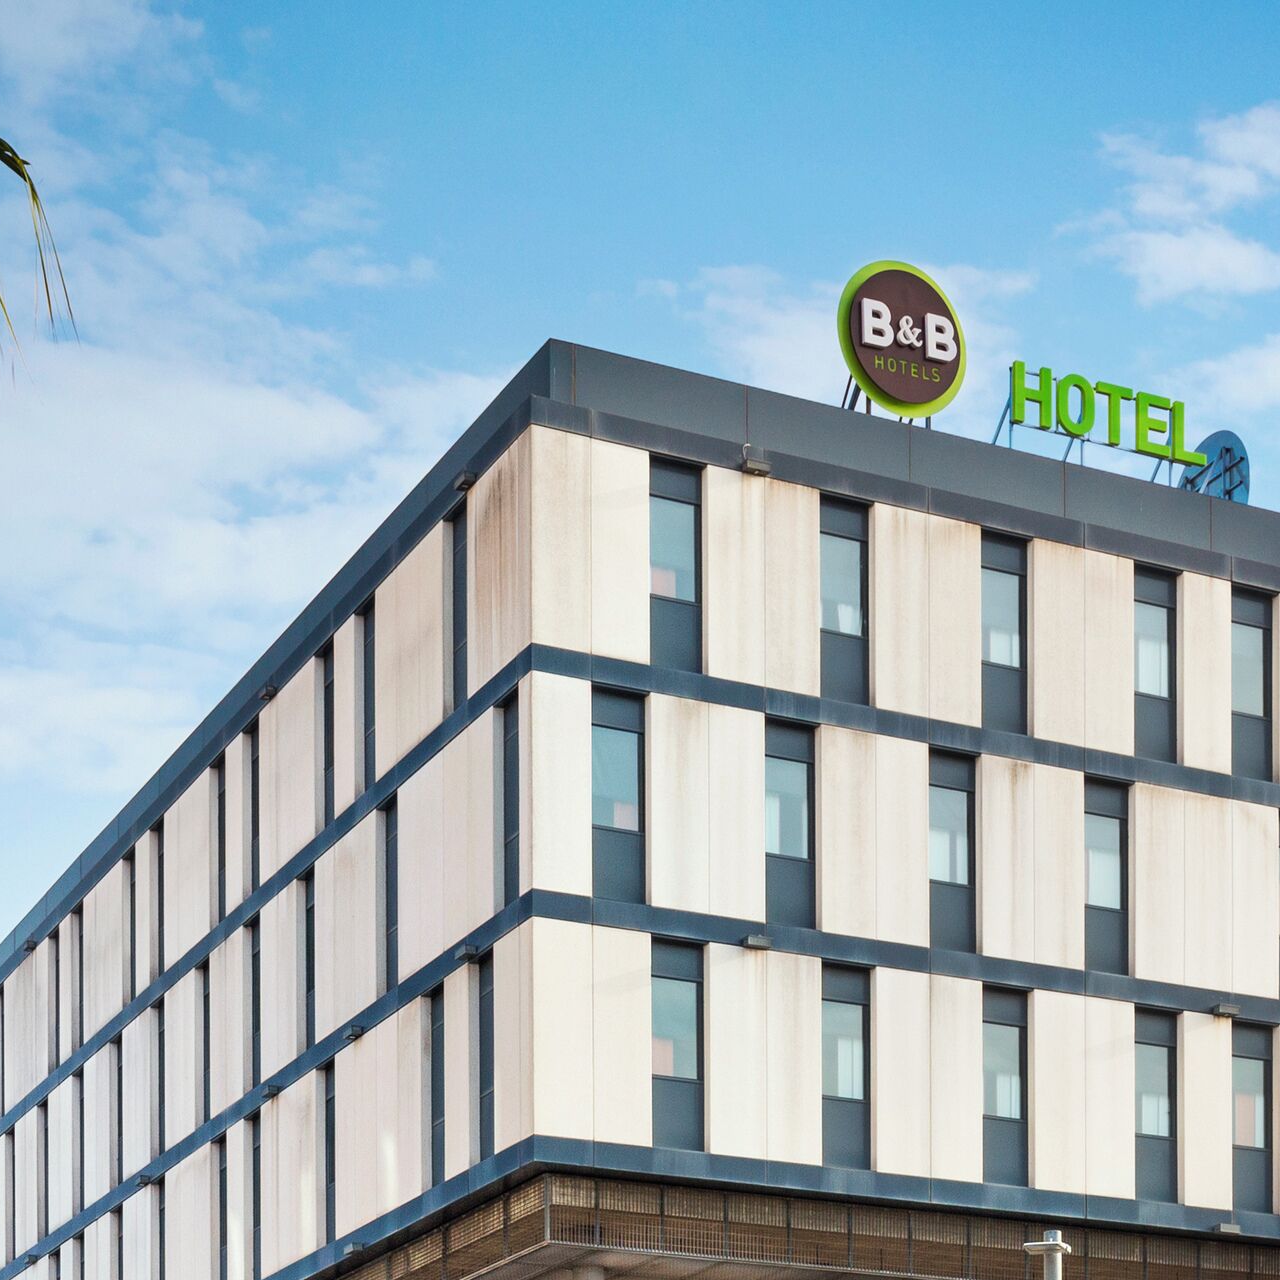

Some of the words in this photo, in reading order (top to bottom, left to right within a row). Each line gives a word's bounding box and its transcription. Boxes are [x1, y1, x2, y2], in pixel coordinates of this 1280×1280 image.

[861, 297, 958, 362] B&B
[874, 354, 941, 383] HOTELS
[1009, 360, 1208, 467] HOTEL
